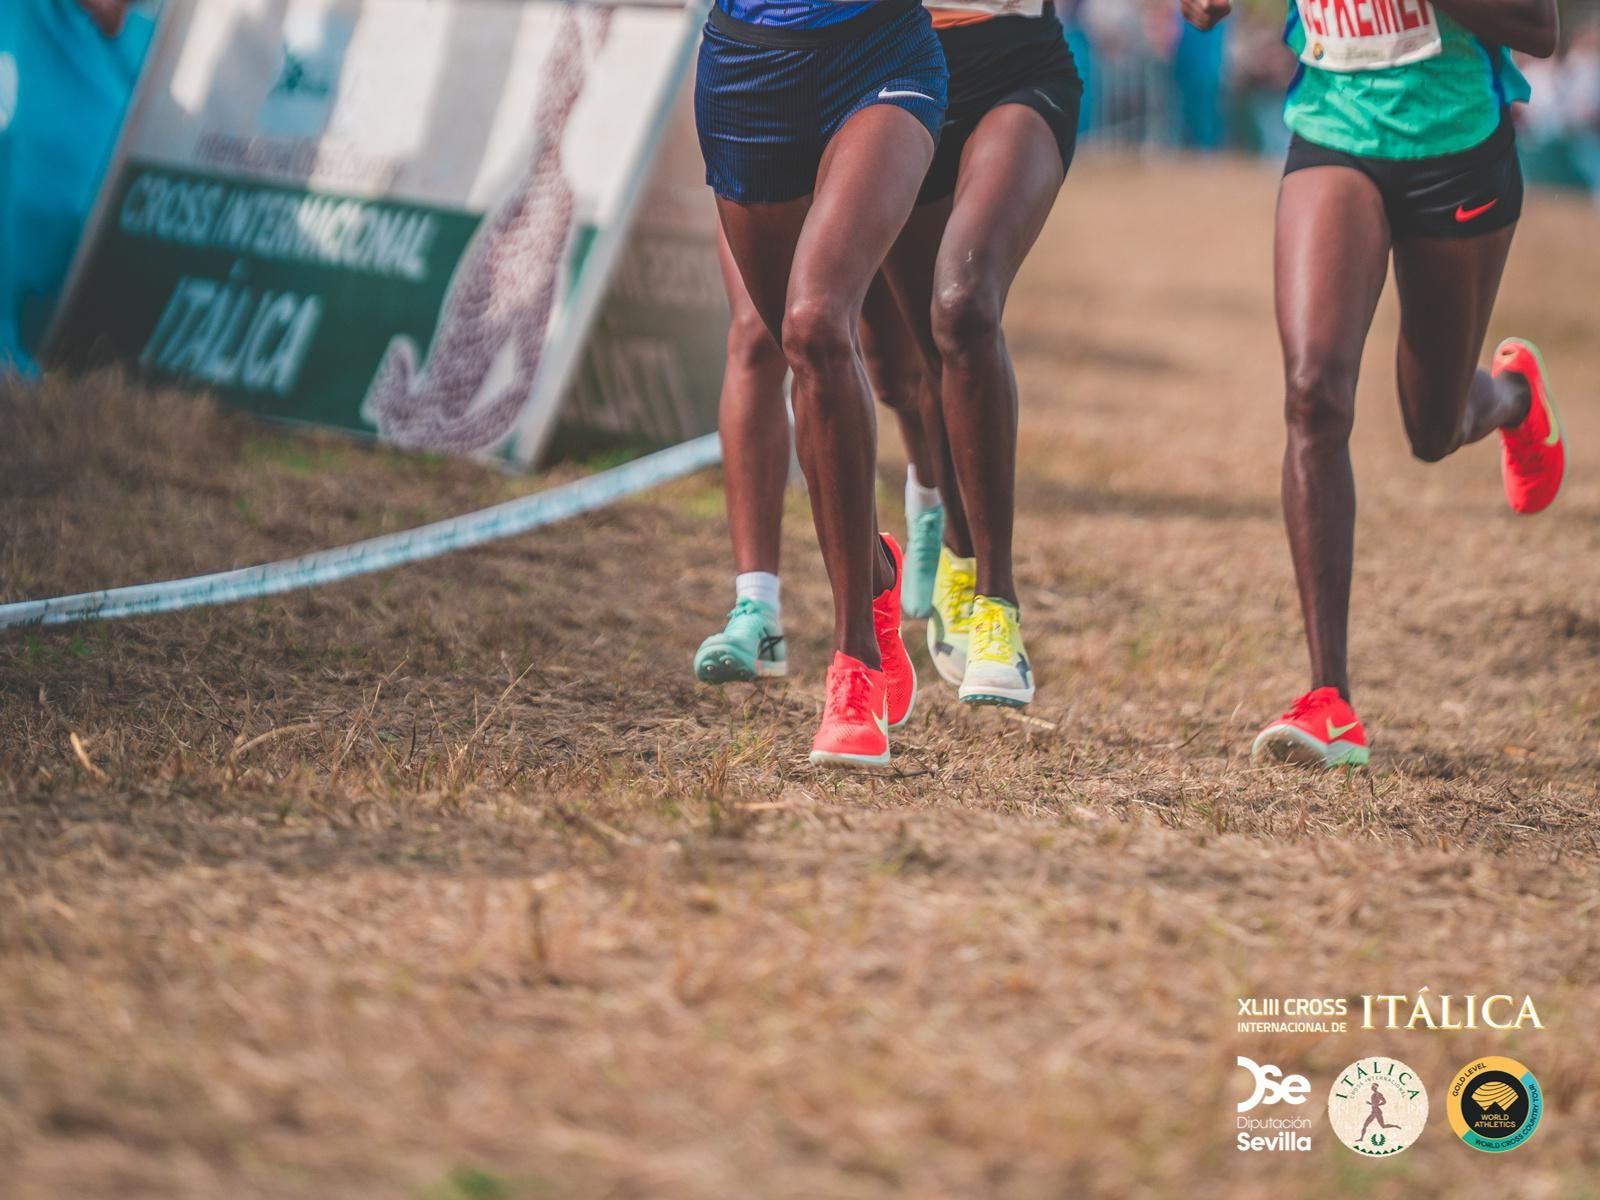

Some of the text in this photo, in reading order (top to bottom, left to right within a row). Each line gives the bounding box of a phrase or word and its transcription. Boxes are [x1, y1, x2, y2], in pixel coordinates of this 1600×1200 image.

[120, 173, 436, 282] CROSS INTERNACIONAL
[138, 257, 323, 396] ITÁLICA
